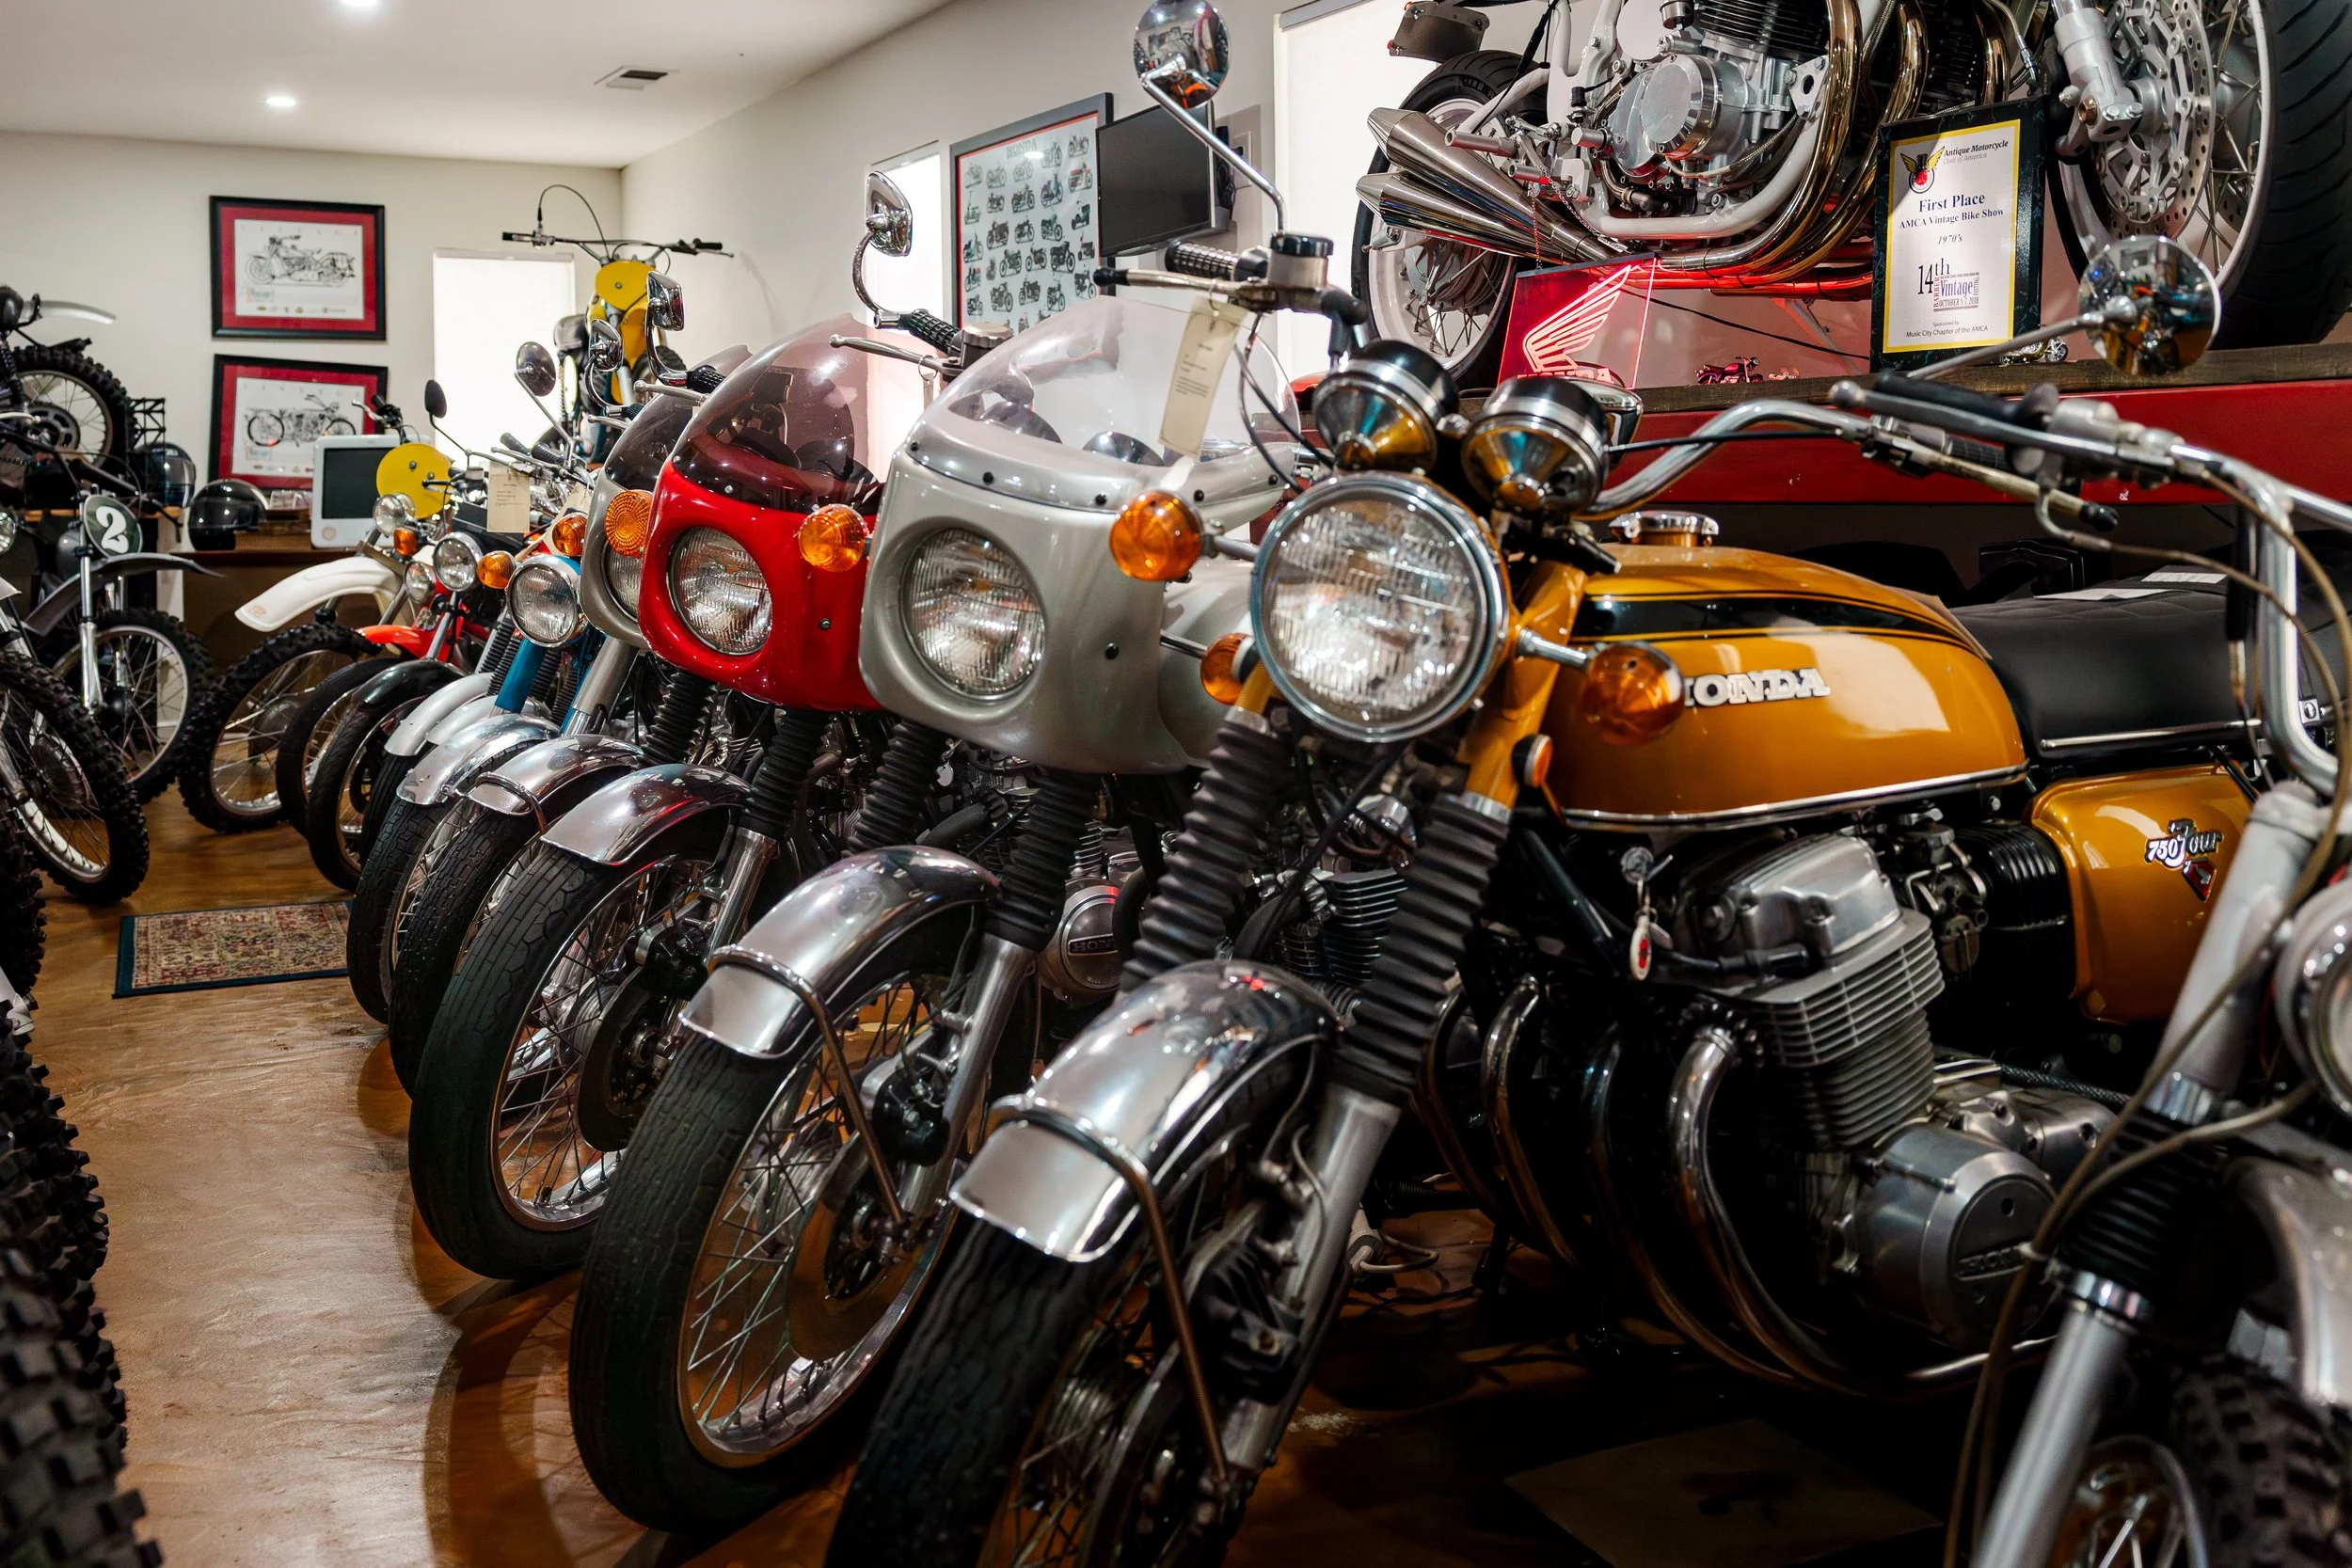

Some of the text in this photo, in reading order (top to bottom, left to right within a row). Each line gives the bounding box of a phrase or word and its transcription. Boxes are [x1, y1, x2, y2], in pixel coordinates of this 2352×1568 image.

[1007, 138, 1038, 159] HONDA
[1944, 140, 2009, 157] Antique Motorcycle
[1963, 152, 1987, 162] America
[1919, 194, 1985, 213] First Place
[1899, 208, 2004, 229] AMCA Vintage Bike Show
[1938, 233, 1963, 245] 1970's
[1940, 279, 1973, 297] Vintage
[1939, 298, 1960, 308] OCTOBER
[96, 505, 129, 554] 2
